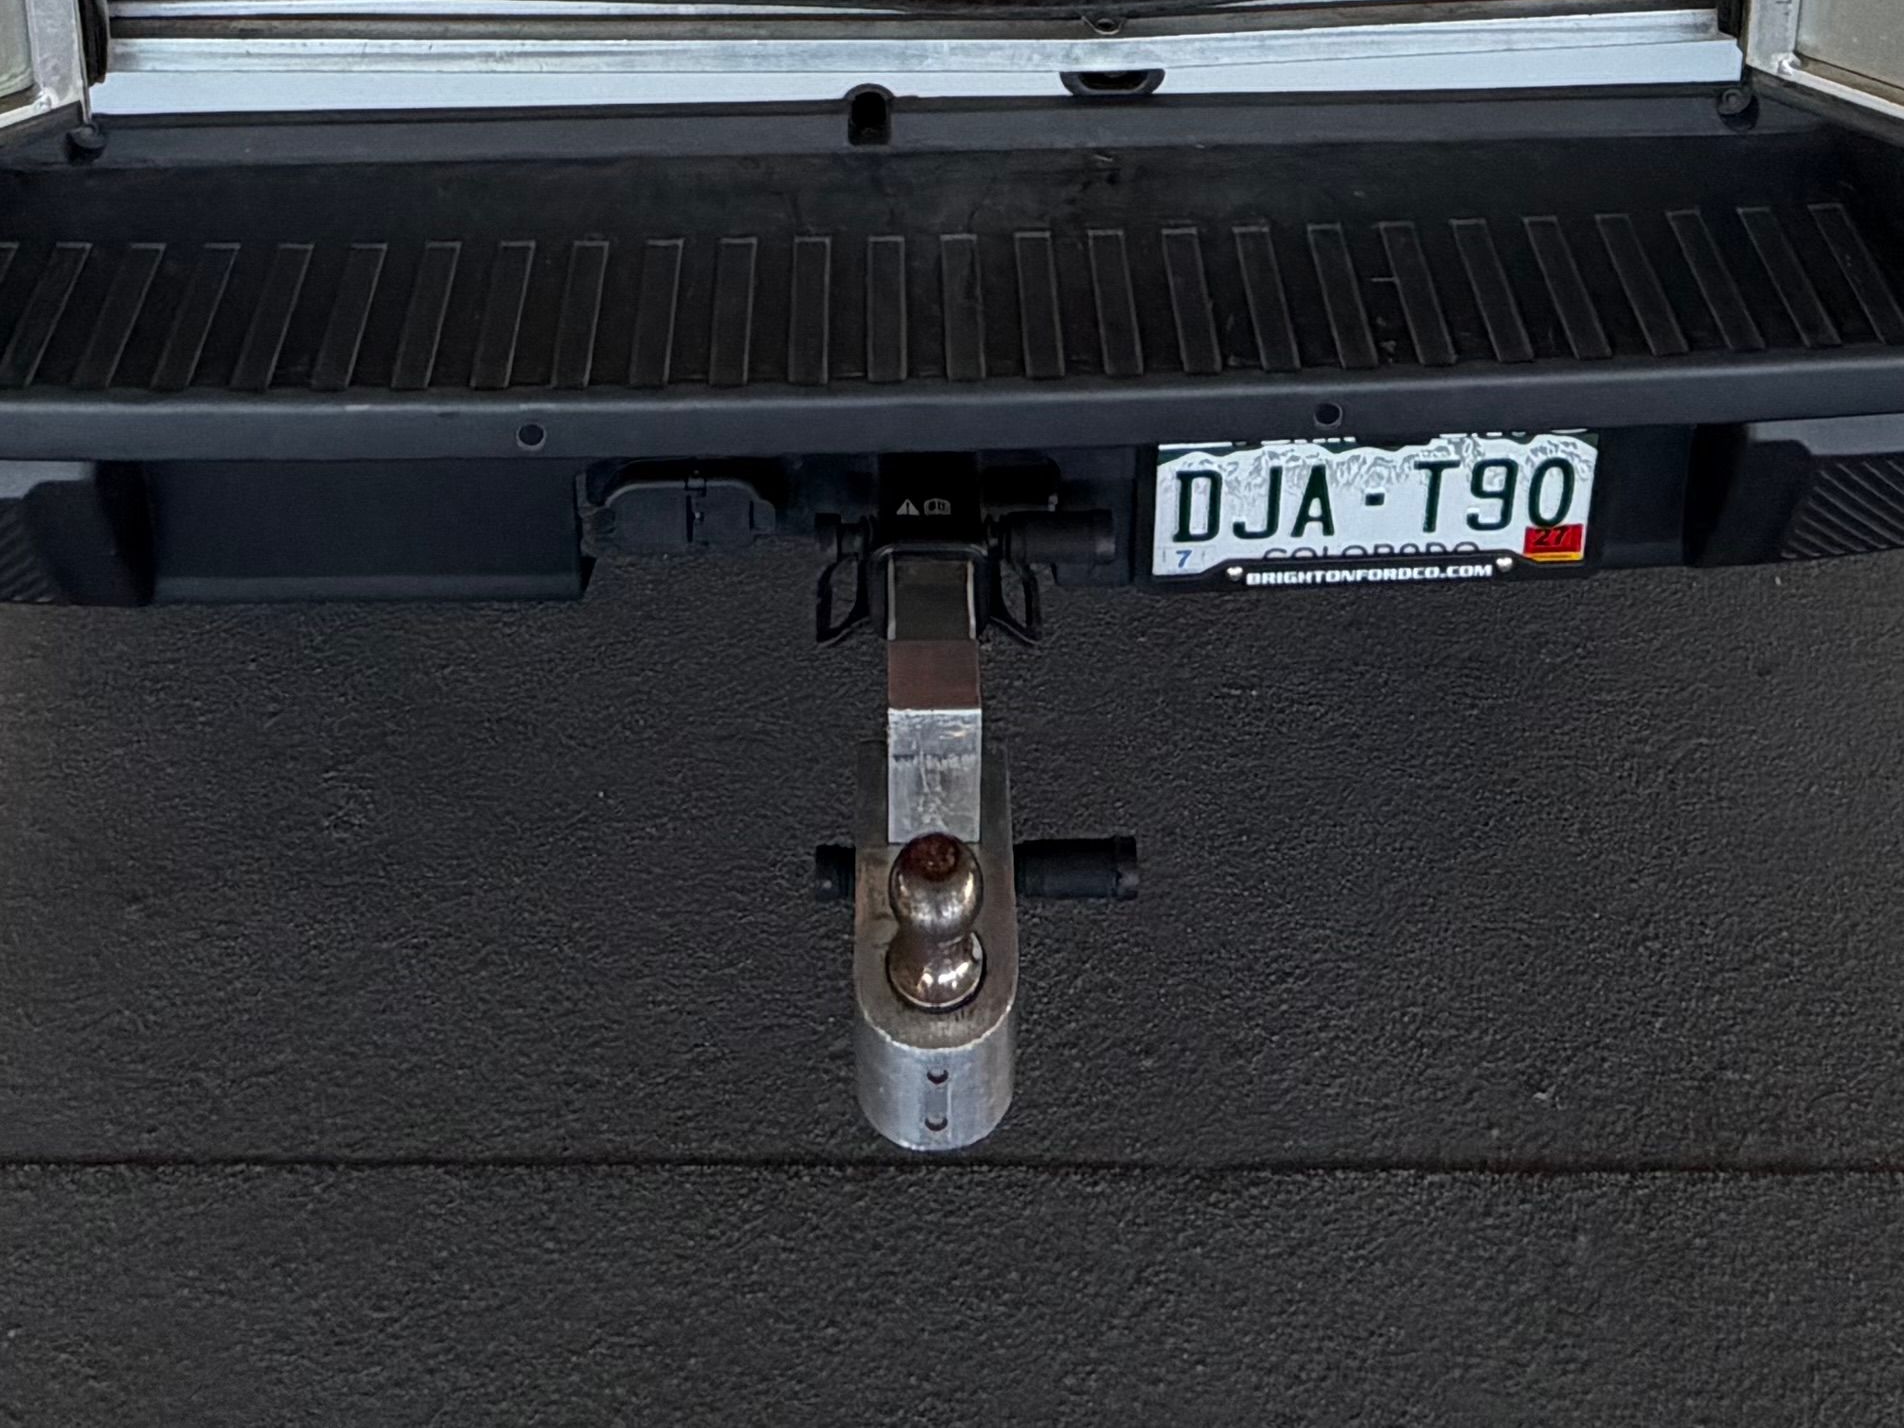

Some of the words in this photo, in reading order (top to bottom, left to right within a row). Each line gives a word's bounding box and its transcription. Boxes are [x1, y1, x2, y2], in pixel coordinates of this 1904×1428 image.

[1534, 528, 1567, 546] 27
[1177, 550, 1192, 569] 7
[1246, 563, 1493, 586] BRIGHTONFORDCO.COM
